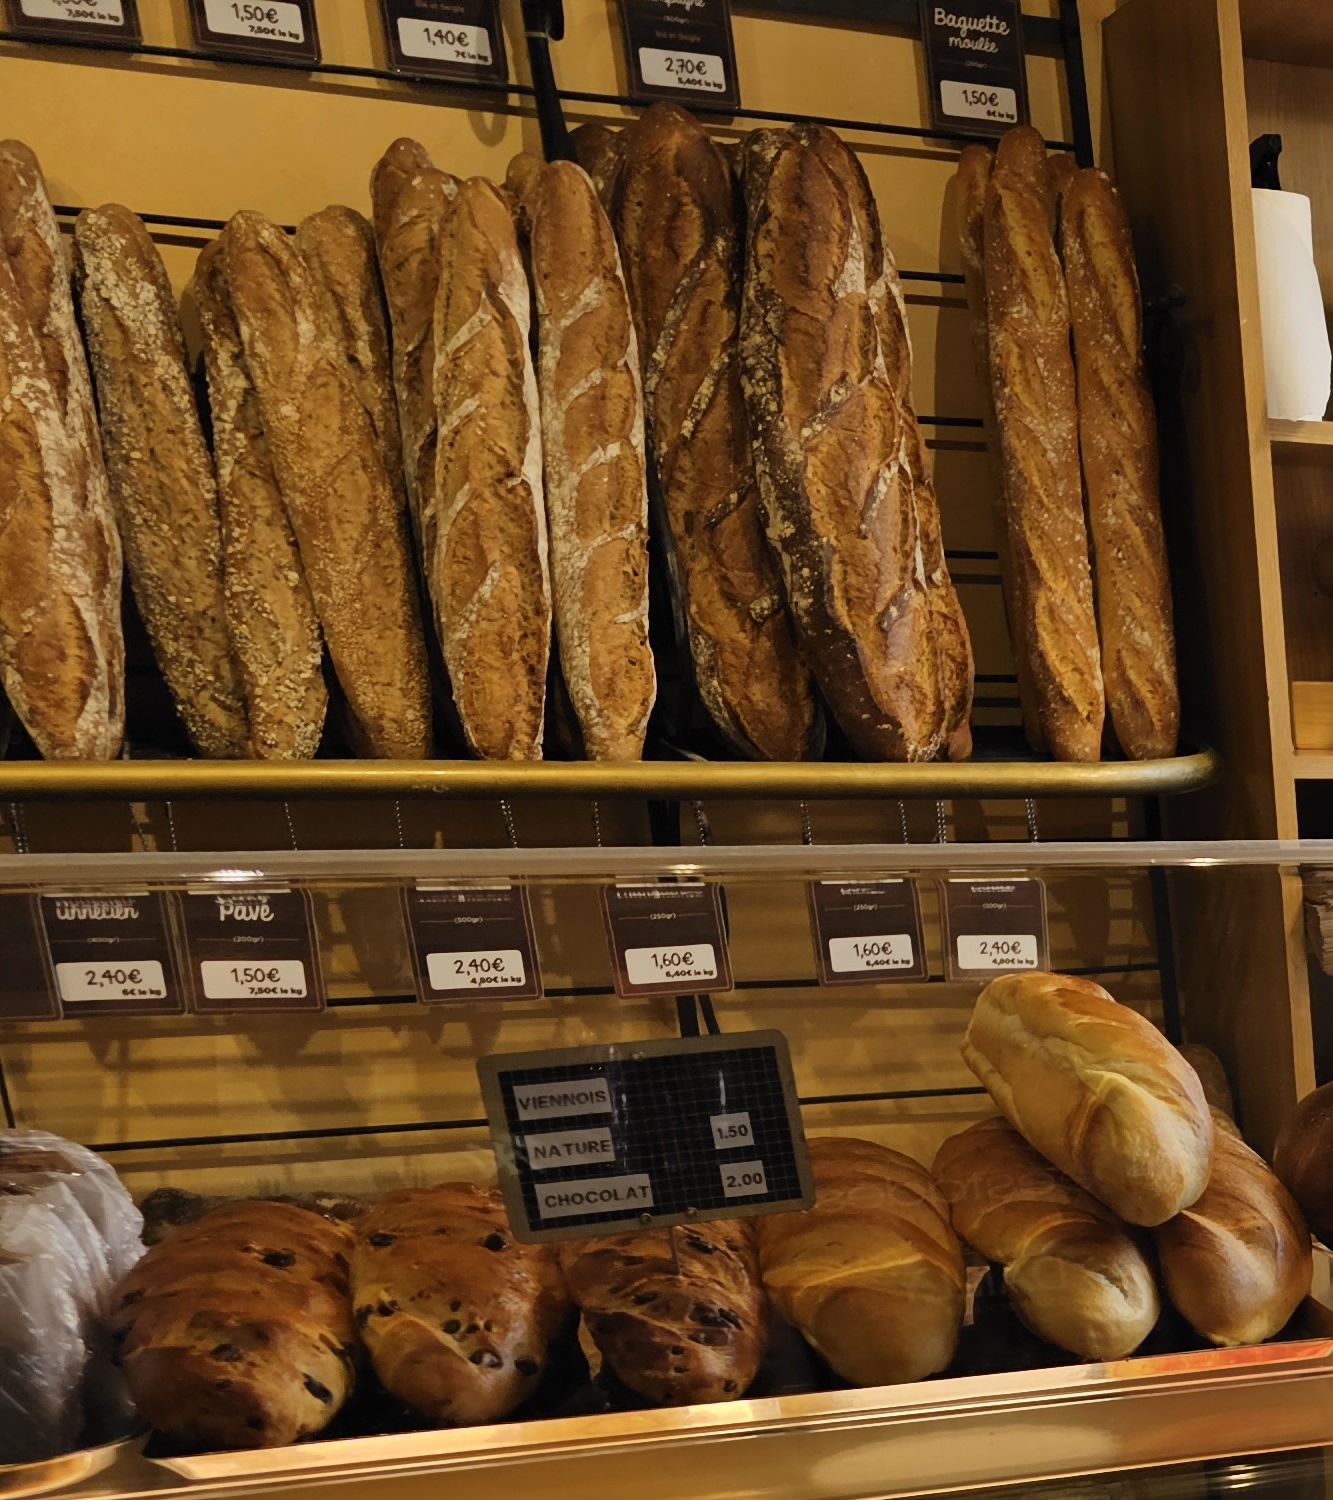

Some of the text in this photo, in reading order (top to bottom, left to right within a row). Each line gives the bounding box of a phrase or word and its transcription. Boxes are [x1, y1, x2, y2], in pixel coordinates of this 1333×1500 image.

[231, 3, 279, 24] 1,50€
[934, 7, 1010, 37] Baguette
[423, 27, 469, 47] 1,40€
[948, 36, 999, 53] moulée
[664, 57, 707, 75] 2,70€
[962, 90, 999, 107] 1,50€
[853, 942, 893, 959] 1,60€
[980, 941, 1021, 956] 2,40€
[453, 958, 505, 976] 2,40€
[651, 951, 694, 969] 1,60€
[85, 969, 143, 987] 2,40€
[231, 967, 281, 985] 1,50€
[518, 1090, 607, 1111] VIENNOIS
[716, 1124, 748, 1139] 1.50
[533, 1139, 611, 1160] NATURE
[726, 1172, 763, 1188] 2.00
[544, 1186, 649, 1208] CHOCOLAT
